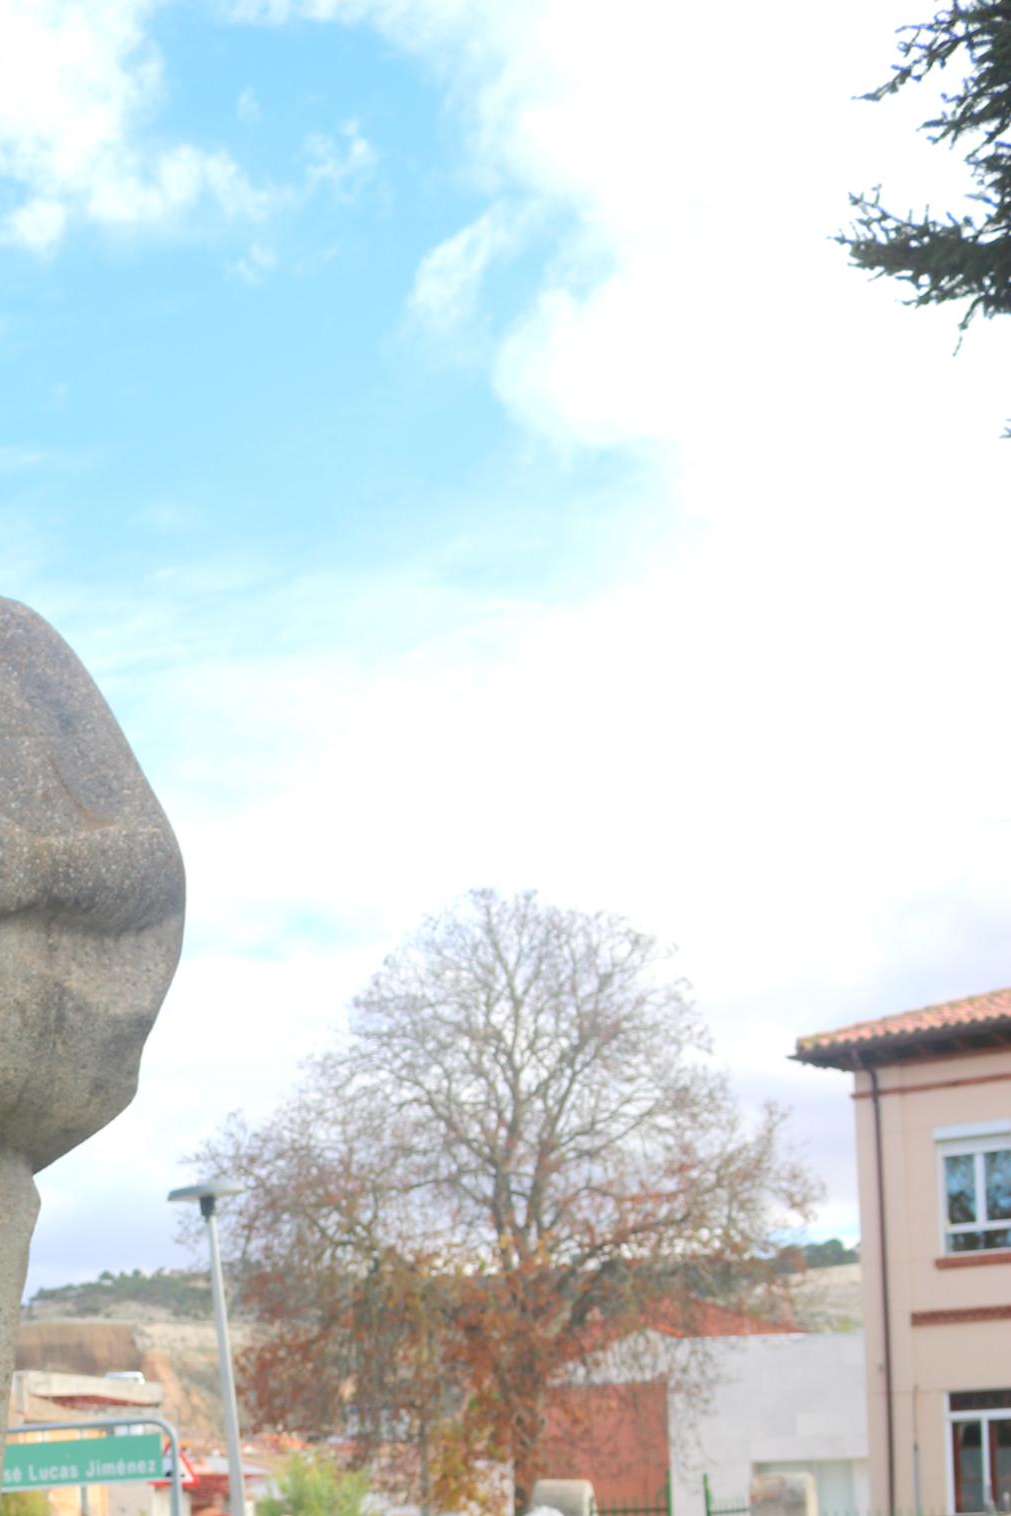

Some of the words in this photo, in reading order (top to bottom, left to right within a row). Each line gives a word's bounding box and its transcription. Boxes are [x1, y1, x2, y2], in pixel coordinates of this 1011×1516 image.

[3, 1467, 22, 1482] sé
[28, 1464, 79, 1481] Lucas
[86, 1458, 156, 1477] Jiménez
